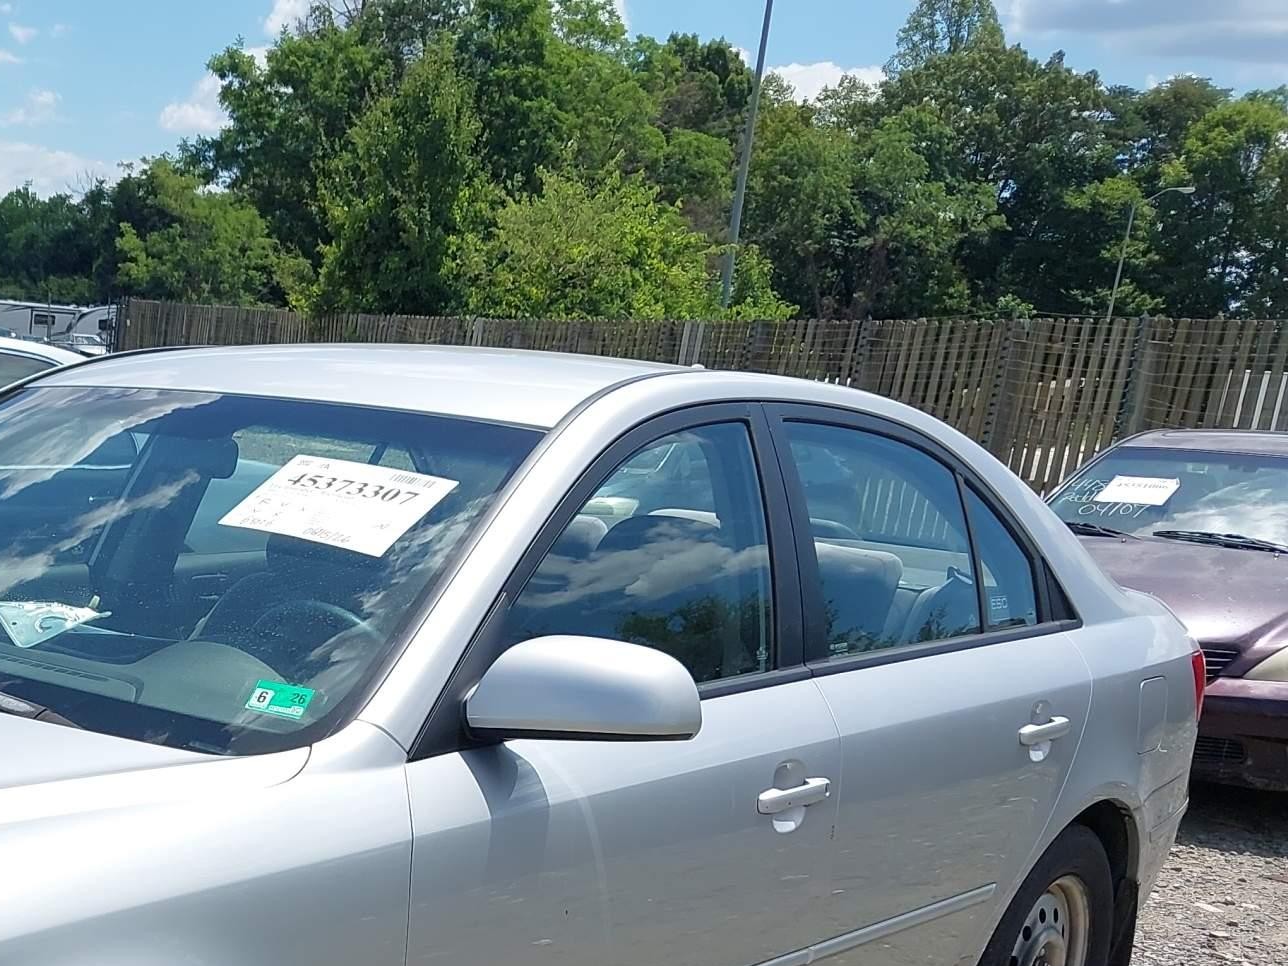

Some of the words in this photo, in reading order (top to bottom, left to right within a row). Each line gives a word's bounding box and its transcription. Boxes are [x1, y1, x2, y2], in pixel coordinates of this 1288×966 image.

[287, 472, 420, 505] 45373307
[257, 691, 269, 703] 6
[291, 693, 307, 705] 26
